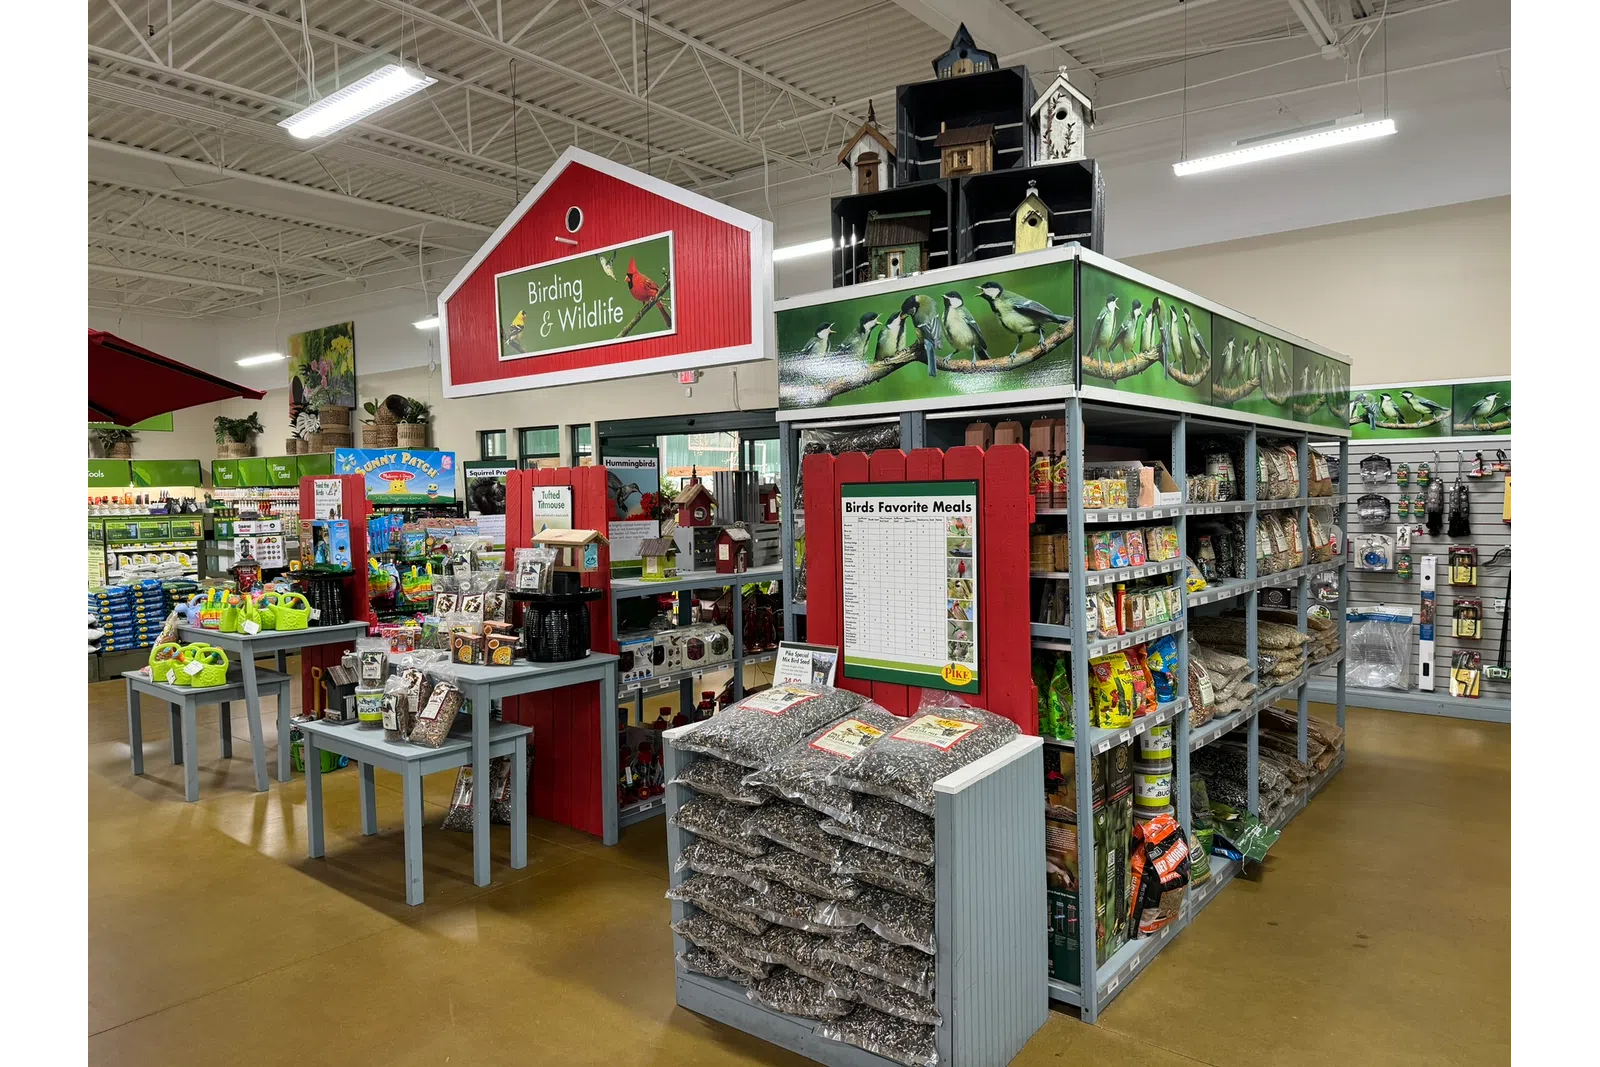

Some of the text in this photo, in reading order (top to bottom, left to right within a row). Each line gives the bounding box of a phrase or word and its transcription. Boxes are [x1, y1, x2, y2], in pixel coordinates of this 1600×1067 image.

[528, 274, 583, 304] Birding
[540, 297, 624, 338] & Wildlife
[401, 452, 438, 478] PATCH
[605, 459, 656, 469] Hummingbirds
[541, 490, 561, 500] Tufted
[538, 500, 565, 509] Titmouse
[845, 500, 972, 513] Birds Favorite Meals
[795, 651, 809, 659] Special
[945, 667, 970, 680] PIKE
